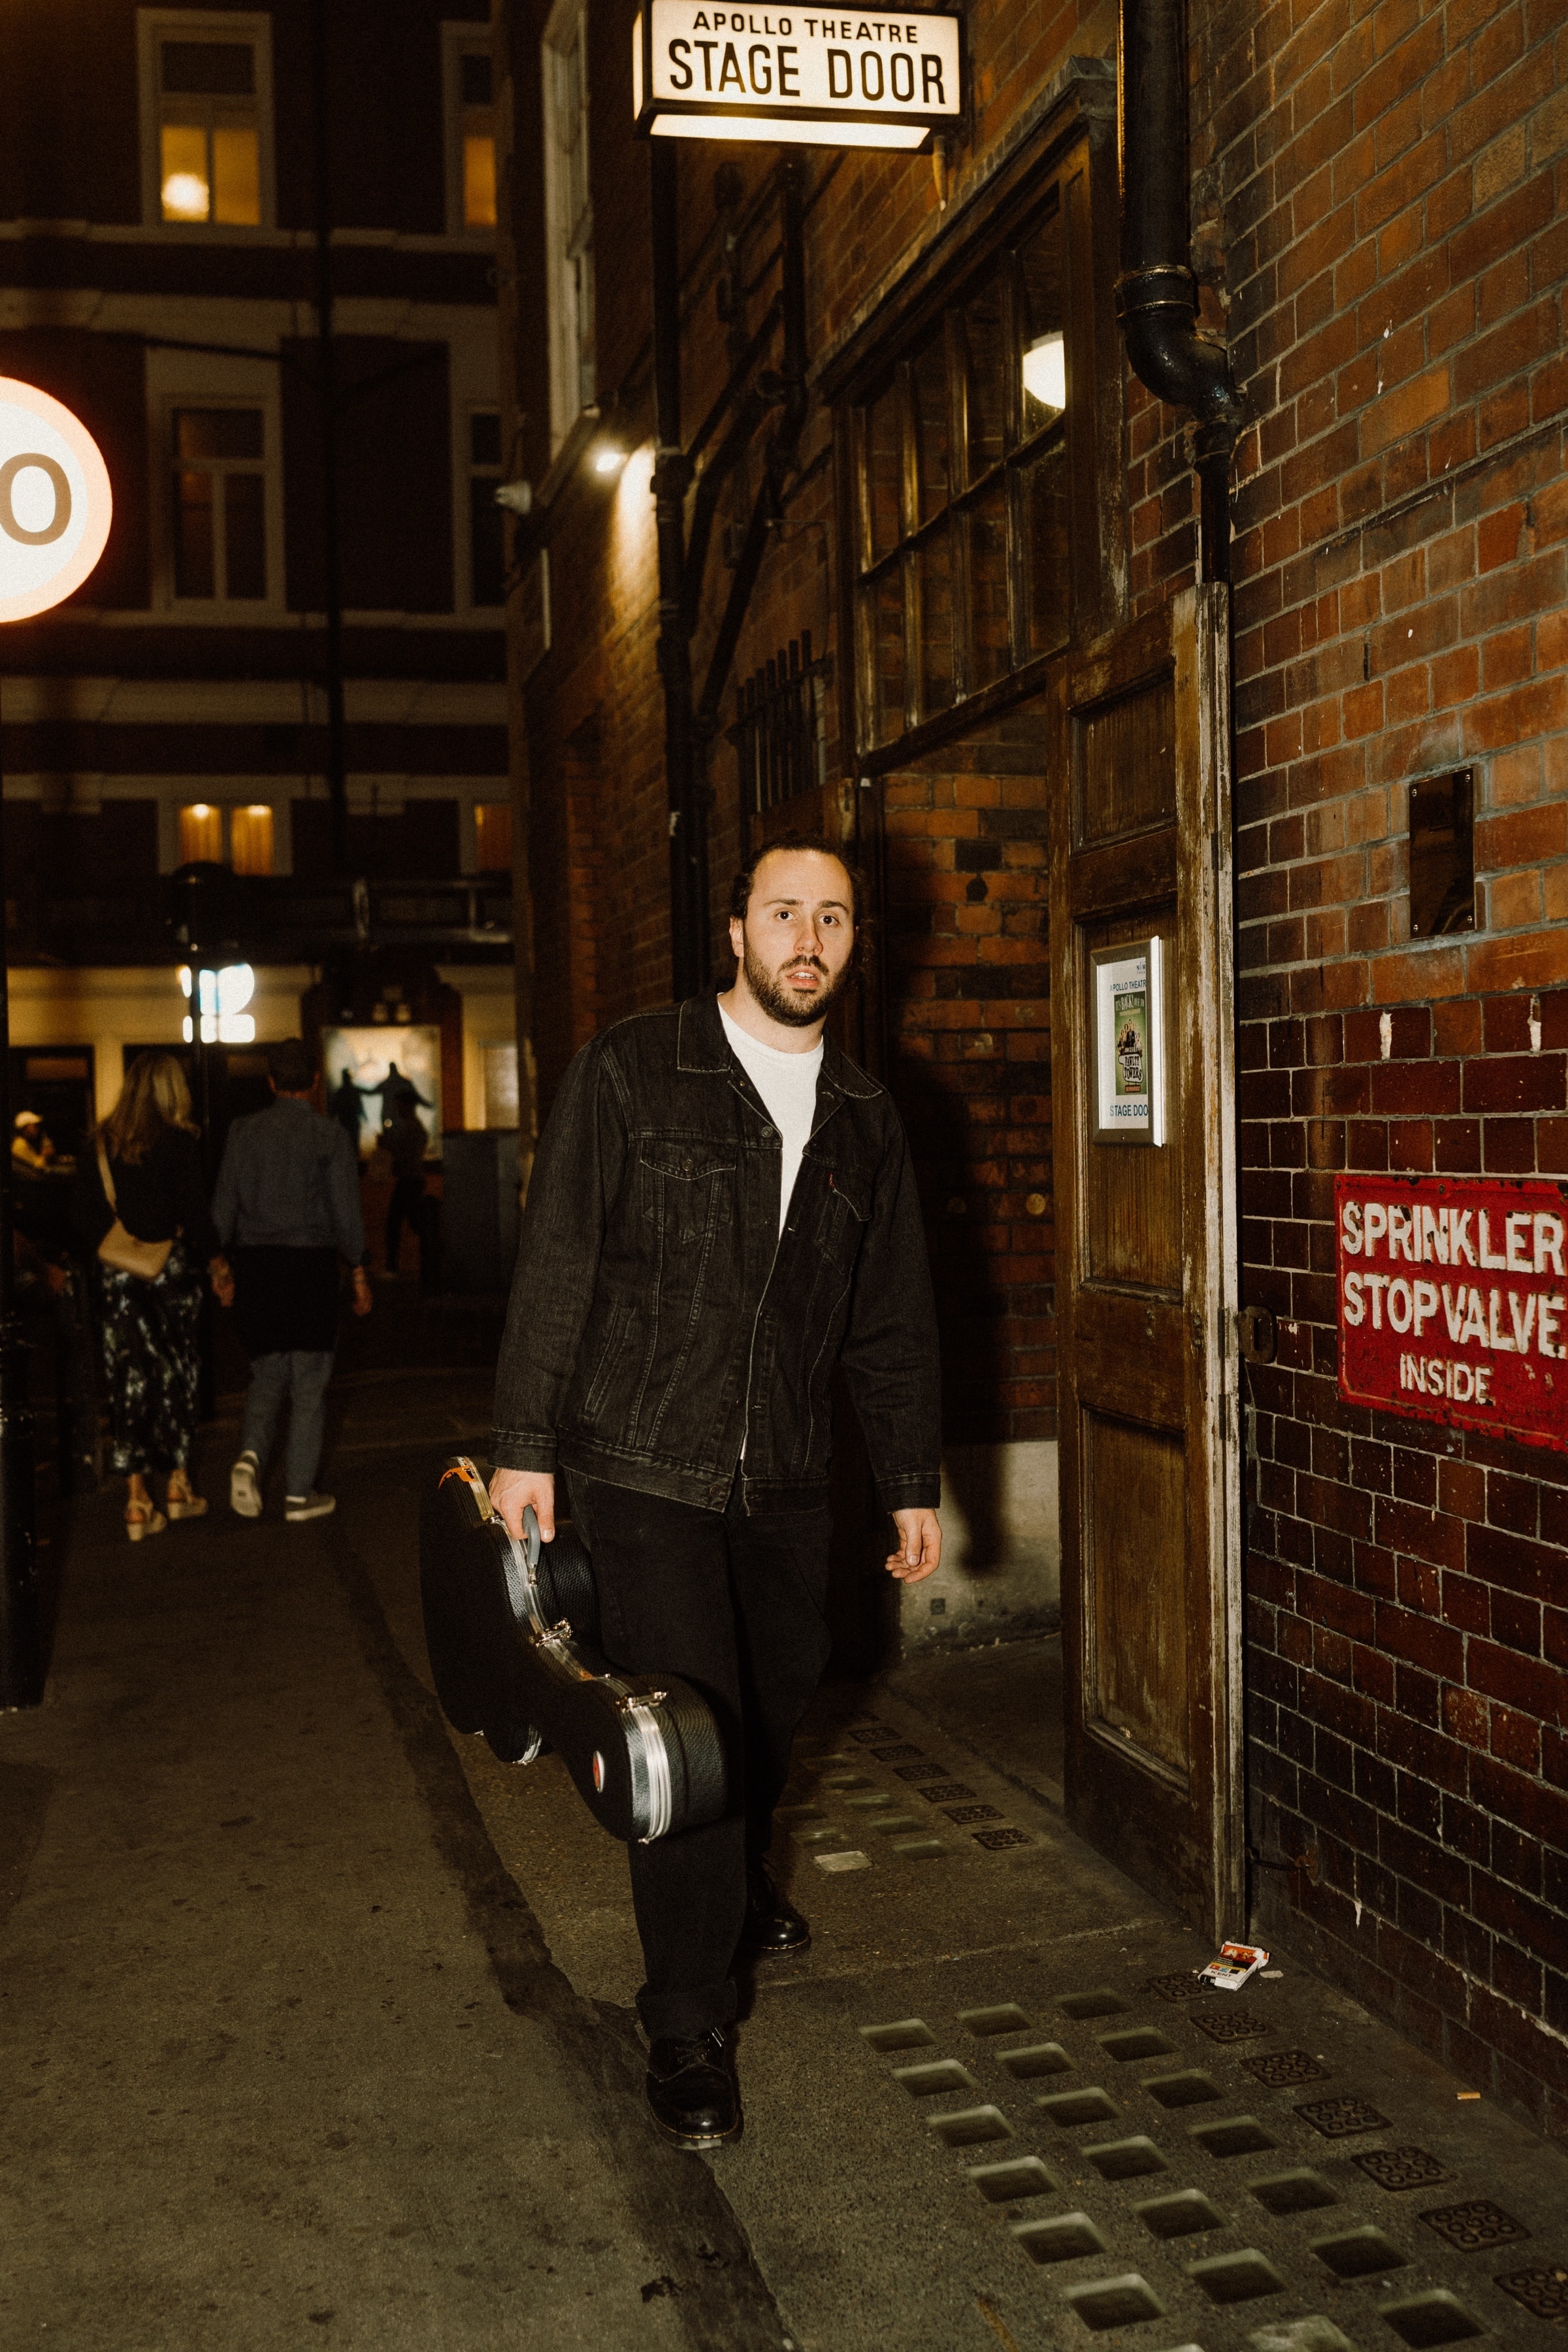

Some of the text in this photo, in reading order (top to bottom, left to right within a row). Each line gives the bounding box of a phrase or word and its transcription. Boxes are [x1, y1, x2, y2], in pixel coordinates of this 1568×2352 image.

[693, 11, 919, 44] APOLLO THEATRE
[668, 38, 946, 105] STAGE DOOR
[1110, 982, 1128, 992] APOLLO
[1124, 1066, 1142, 1081] TOWERS
[1110, 1104, 1132, 1117] STAGE
[1342, 1201, 1566, 1277] SPRINKLER
